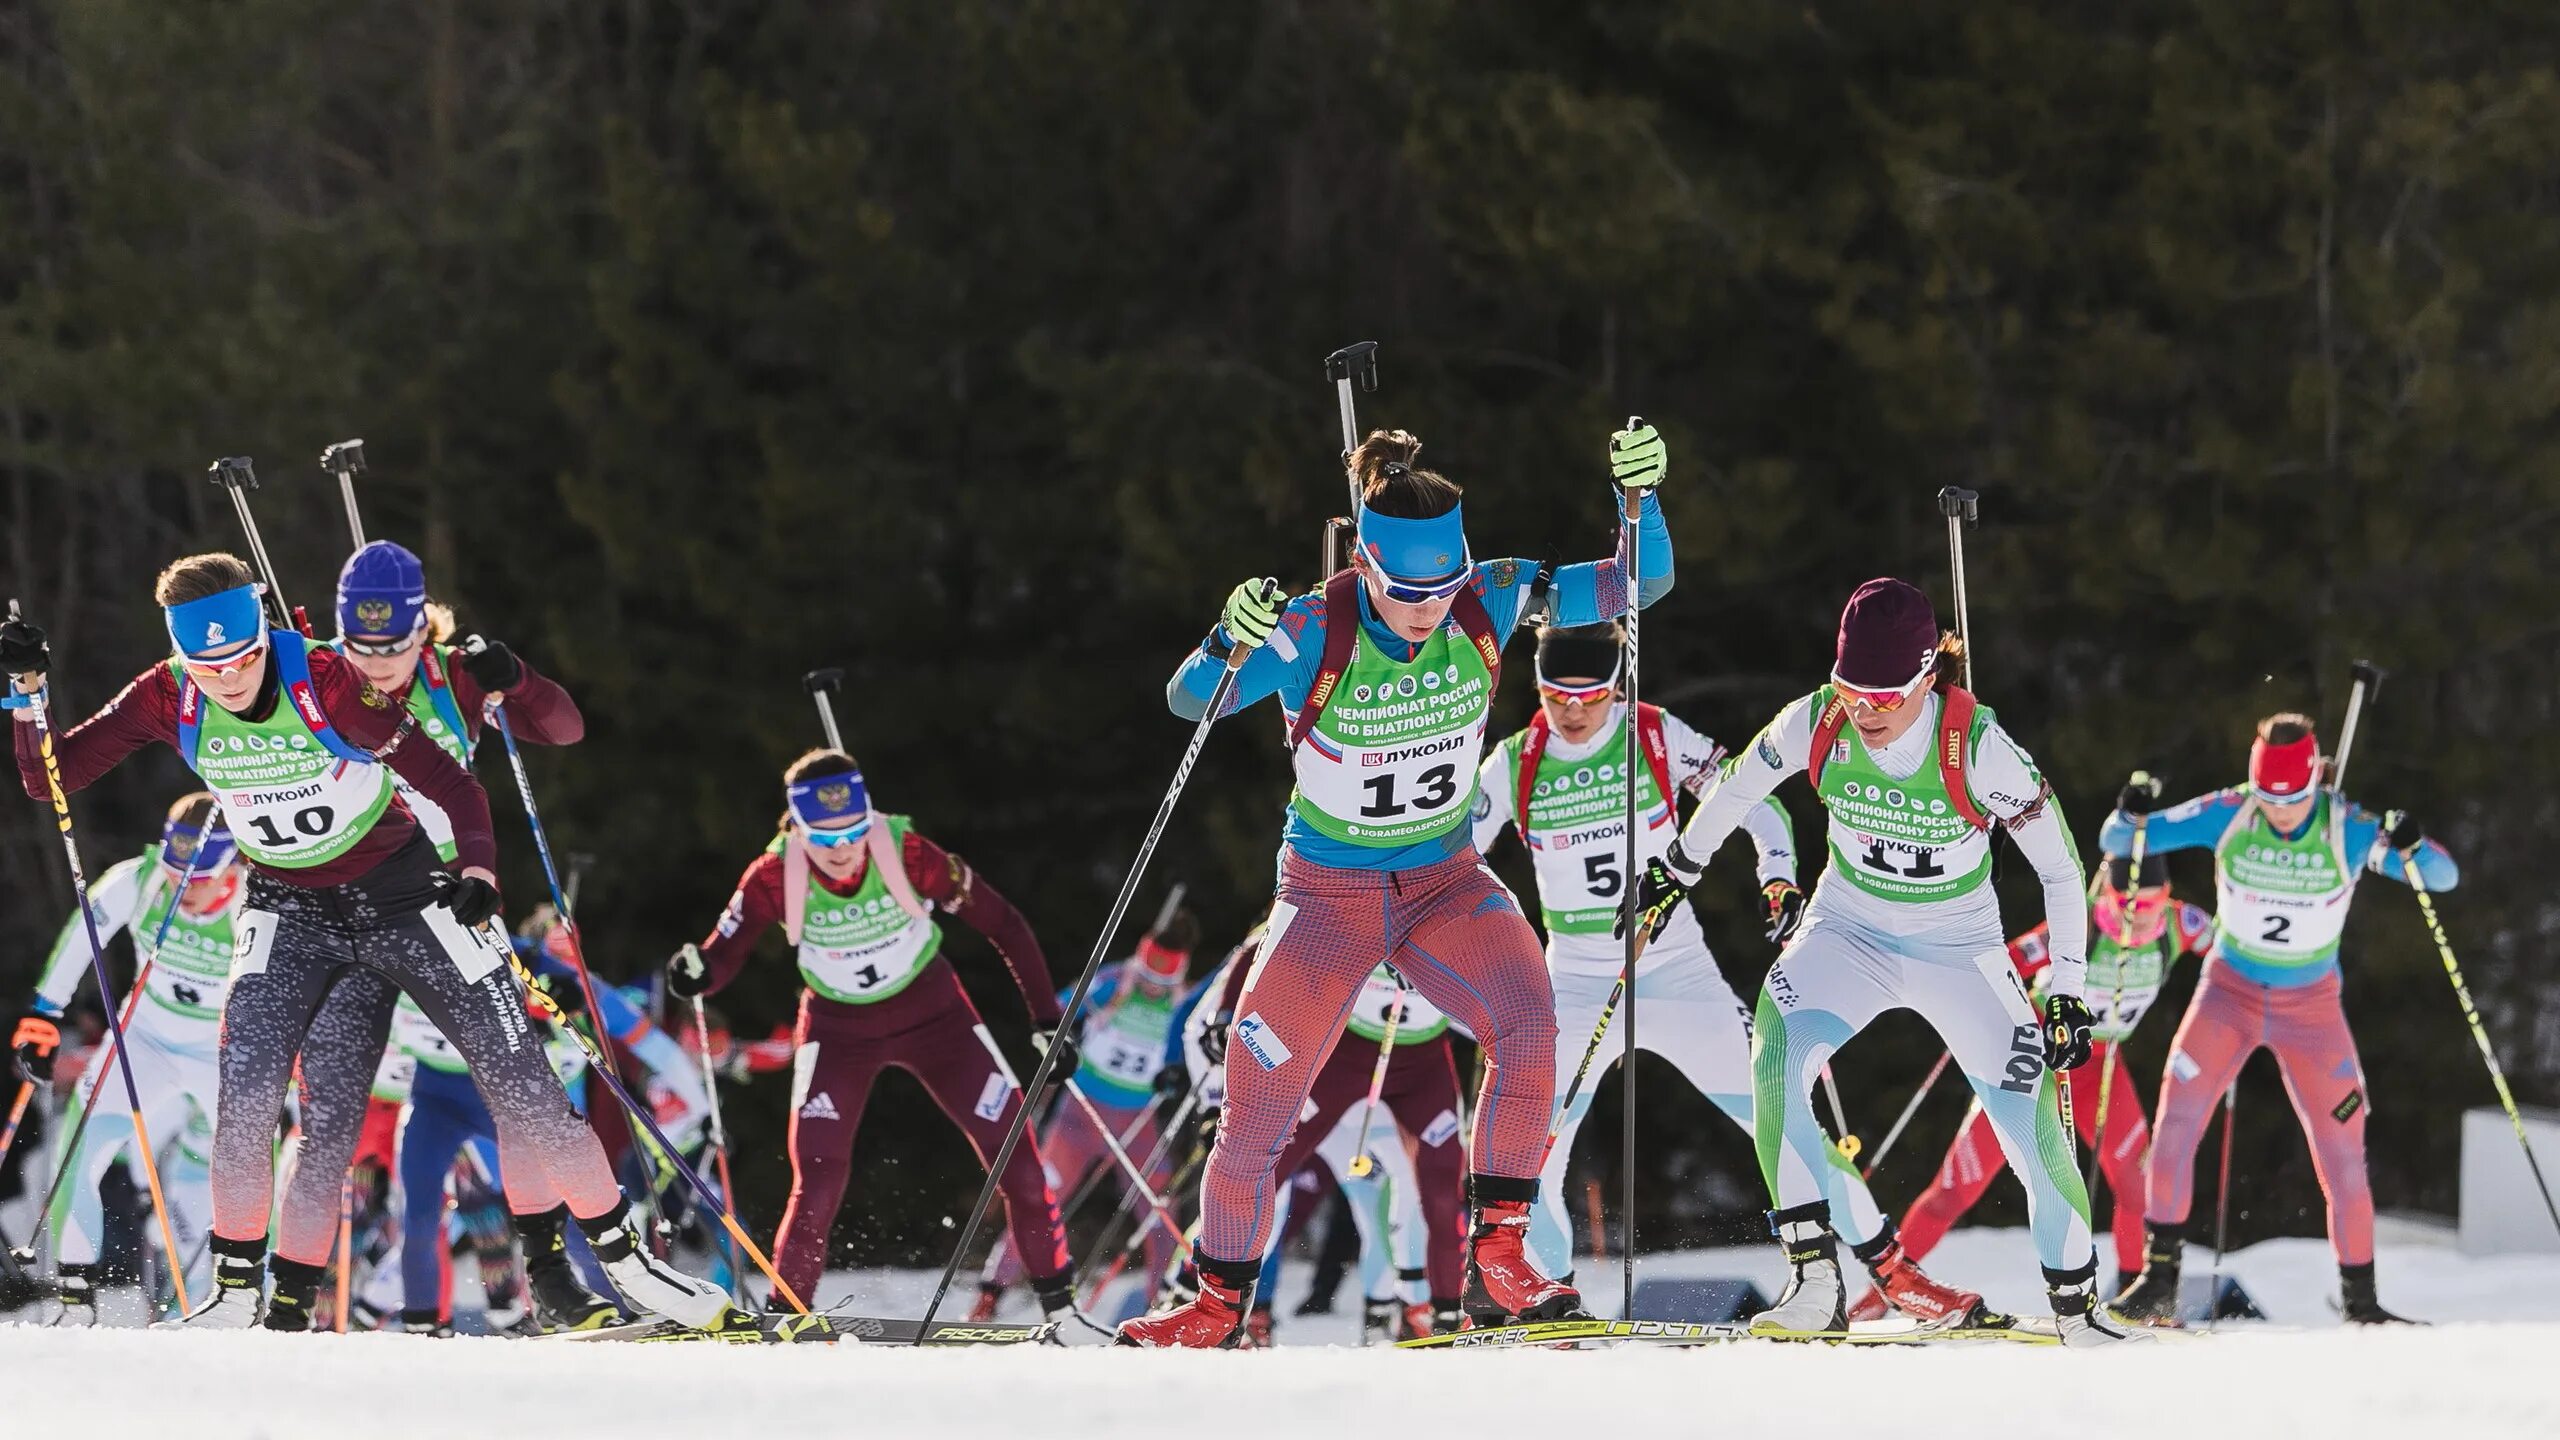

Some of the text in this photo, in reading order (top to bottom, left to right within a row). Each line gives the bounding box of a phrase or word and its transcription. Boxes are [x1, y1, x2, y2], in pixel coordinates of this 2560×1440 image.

[1479, 634, 1498, 667] START
[1312, 671, 1336, 707] START
[1333, 677, 1482, 721] ЧЕМПИОНАТ РОССИИ
[1338, 723, 1359, 736] ПО
[1362, 710, 1446, 737] БИАТЛОНУ
[1384, 736, 1465, 764] ЛУКОЙЛ
[1948, 729, 1960, 769] START
[225, 763, 296, 780] БИАТЛОНУ
[252, 784, 323, 805] ЛУКОЙЛ
[1360, 763, 1457, 818] 13
[1361, 808, 1463, 838] UGRAMEGASPORT.RU
[1826, 794, 1910, 823] ЧЕМПИОНАТ
[1833, 805, 1850, 821] ПО
[1851, 814, 1926, 837] БИАТЛОНУ
[249, 805, 335, 847] 10
[1571, 823, 1626, 846] ЛУКОЙ
[1584, 852, 1621, 898] 5
[1862, 845, 1945, 879] 11
[1863, 877, 1958, 894] UGRAMEGASPORT.RU
[2262, 915, 2291, 943] 2
[854, 963, 888, 989] 1
[1769, 963, 1793, 992] RAFT
[482, 976, 521, 1054] ТЮМЕНСКАЯ
[1244, 1036, 1276, 1071] GAZPROM
[1452, 1329, 1531, 1349] FISCHER
